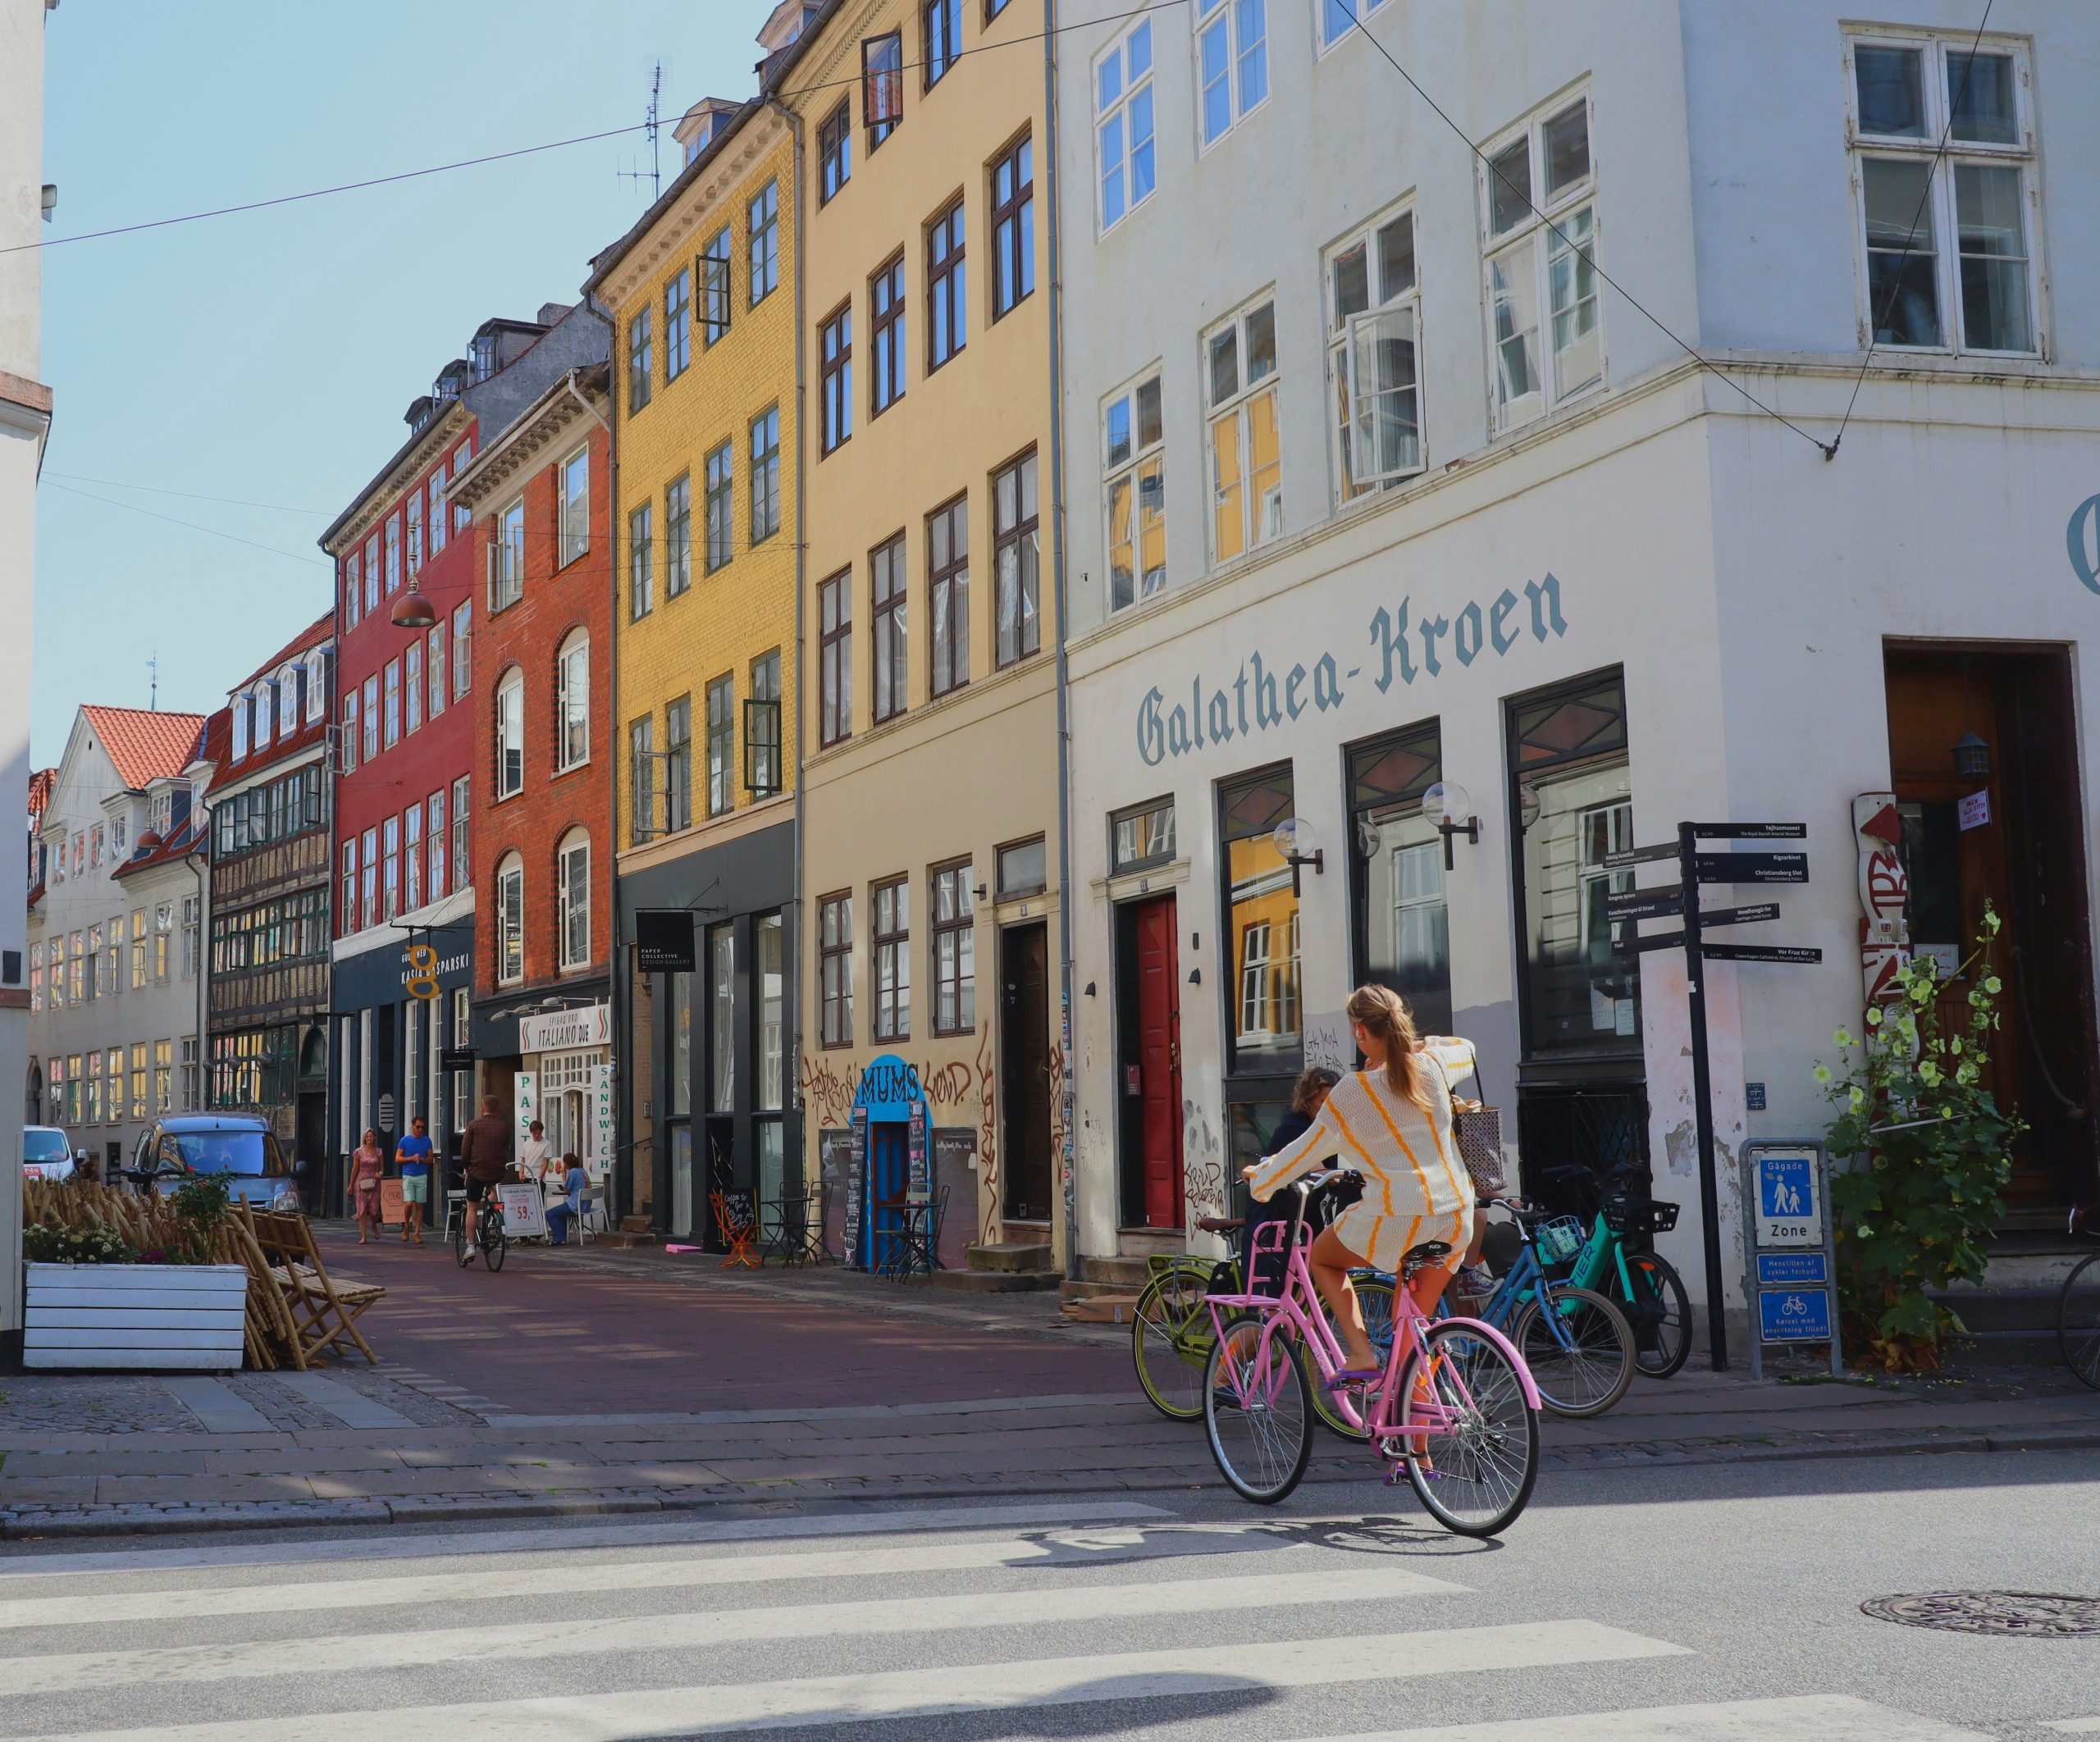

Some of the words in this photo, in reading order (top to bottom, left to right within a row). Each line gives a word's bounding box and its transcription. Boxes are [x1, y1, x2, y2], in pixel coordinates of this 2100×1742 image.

[402, 949, 426, 963] GULMED
[538, 1025, 576, 1048] ITALIANO
[578, 1024, 589, 1043] DUE
[861, 1064, 919, 1105] MUMS
[521, 1077, 531, 1142] PAST
[599, 1068, 609, 1169] SANDWICH
[1767, 1161, 1803, 1171] Gågade
[1771, 1224, 1807, 1237] Zone
[1570, 1245, 1596, 1287] TIER
